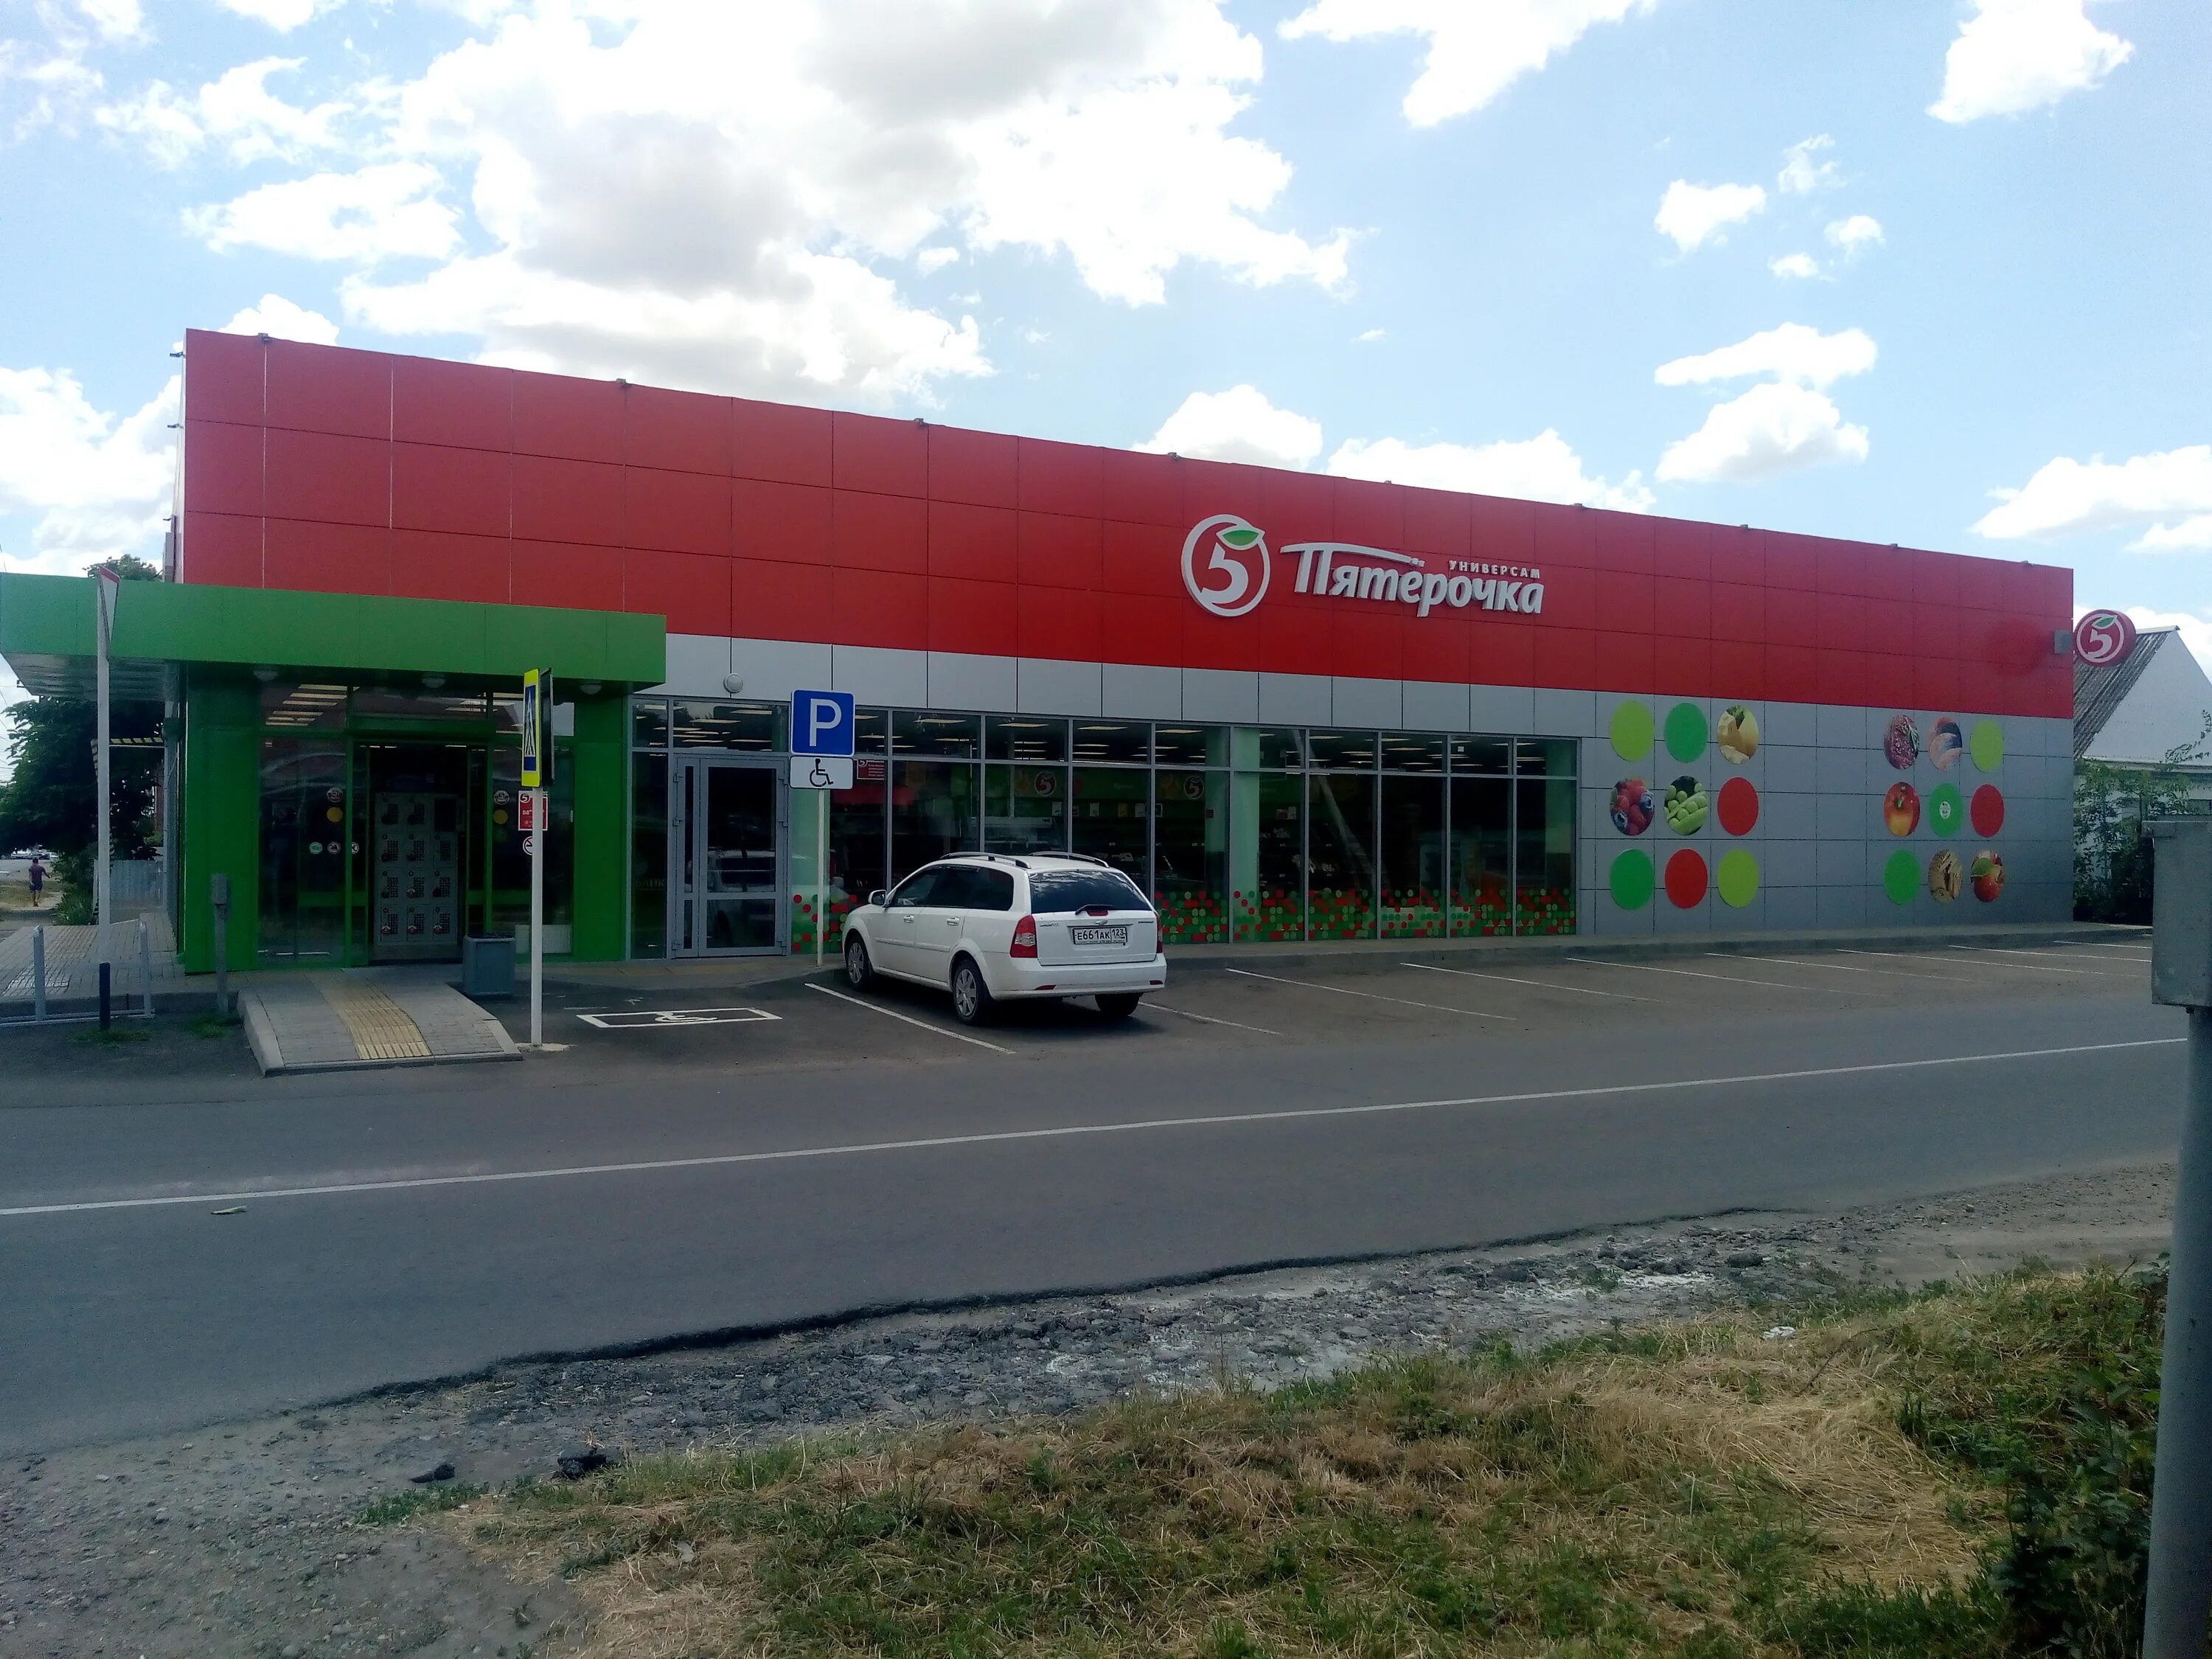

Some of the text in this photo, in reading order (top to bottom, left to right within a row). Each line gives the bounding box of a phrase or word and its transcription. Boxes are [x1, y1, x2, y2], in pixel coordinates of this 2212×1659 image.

[1449, 560, 1540, 579] УНИВЕРСАМ
[809, 698, 842, 747] P
[1111, 928, 1124, 936] 123
